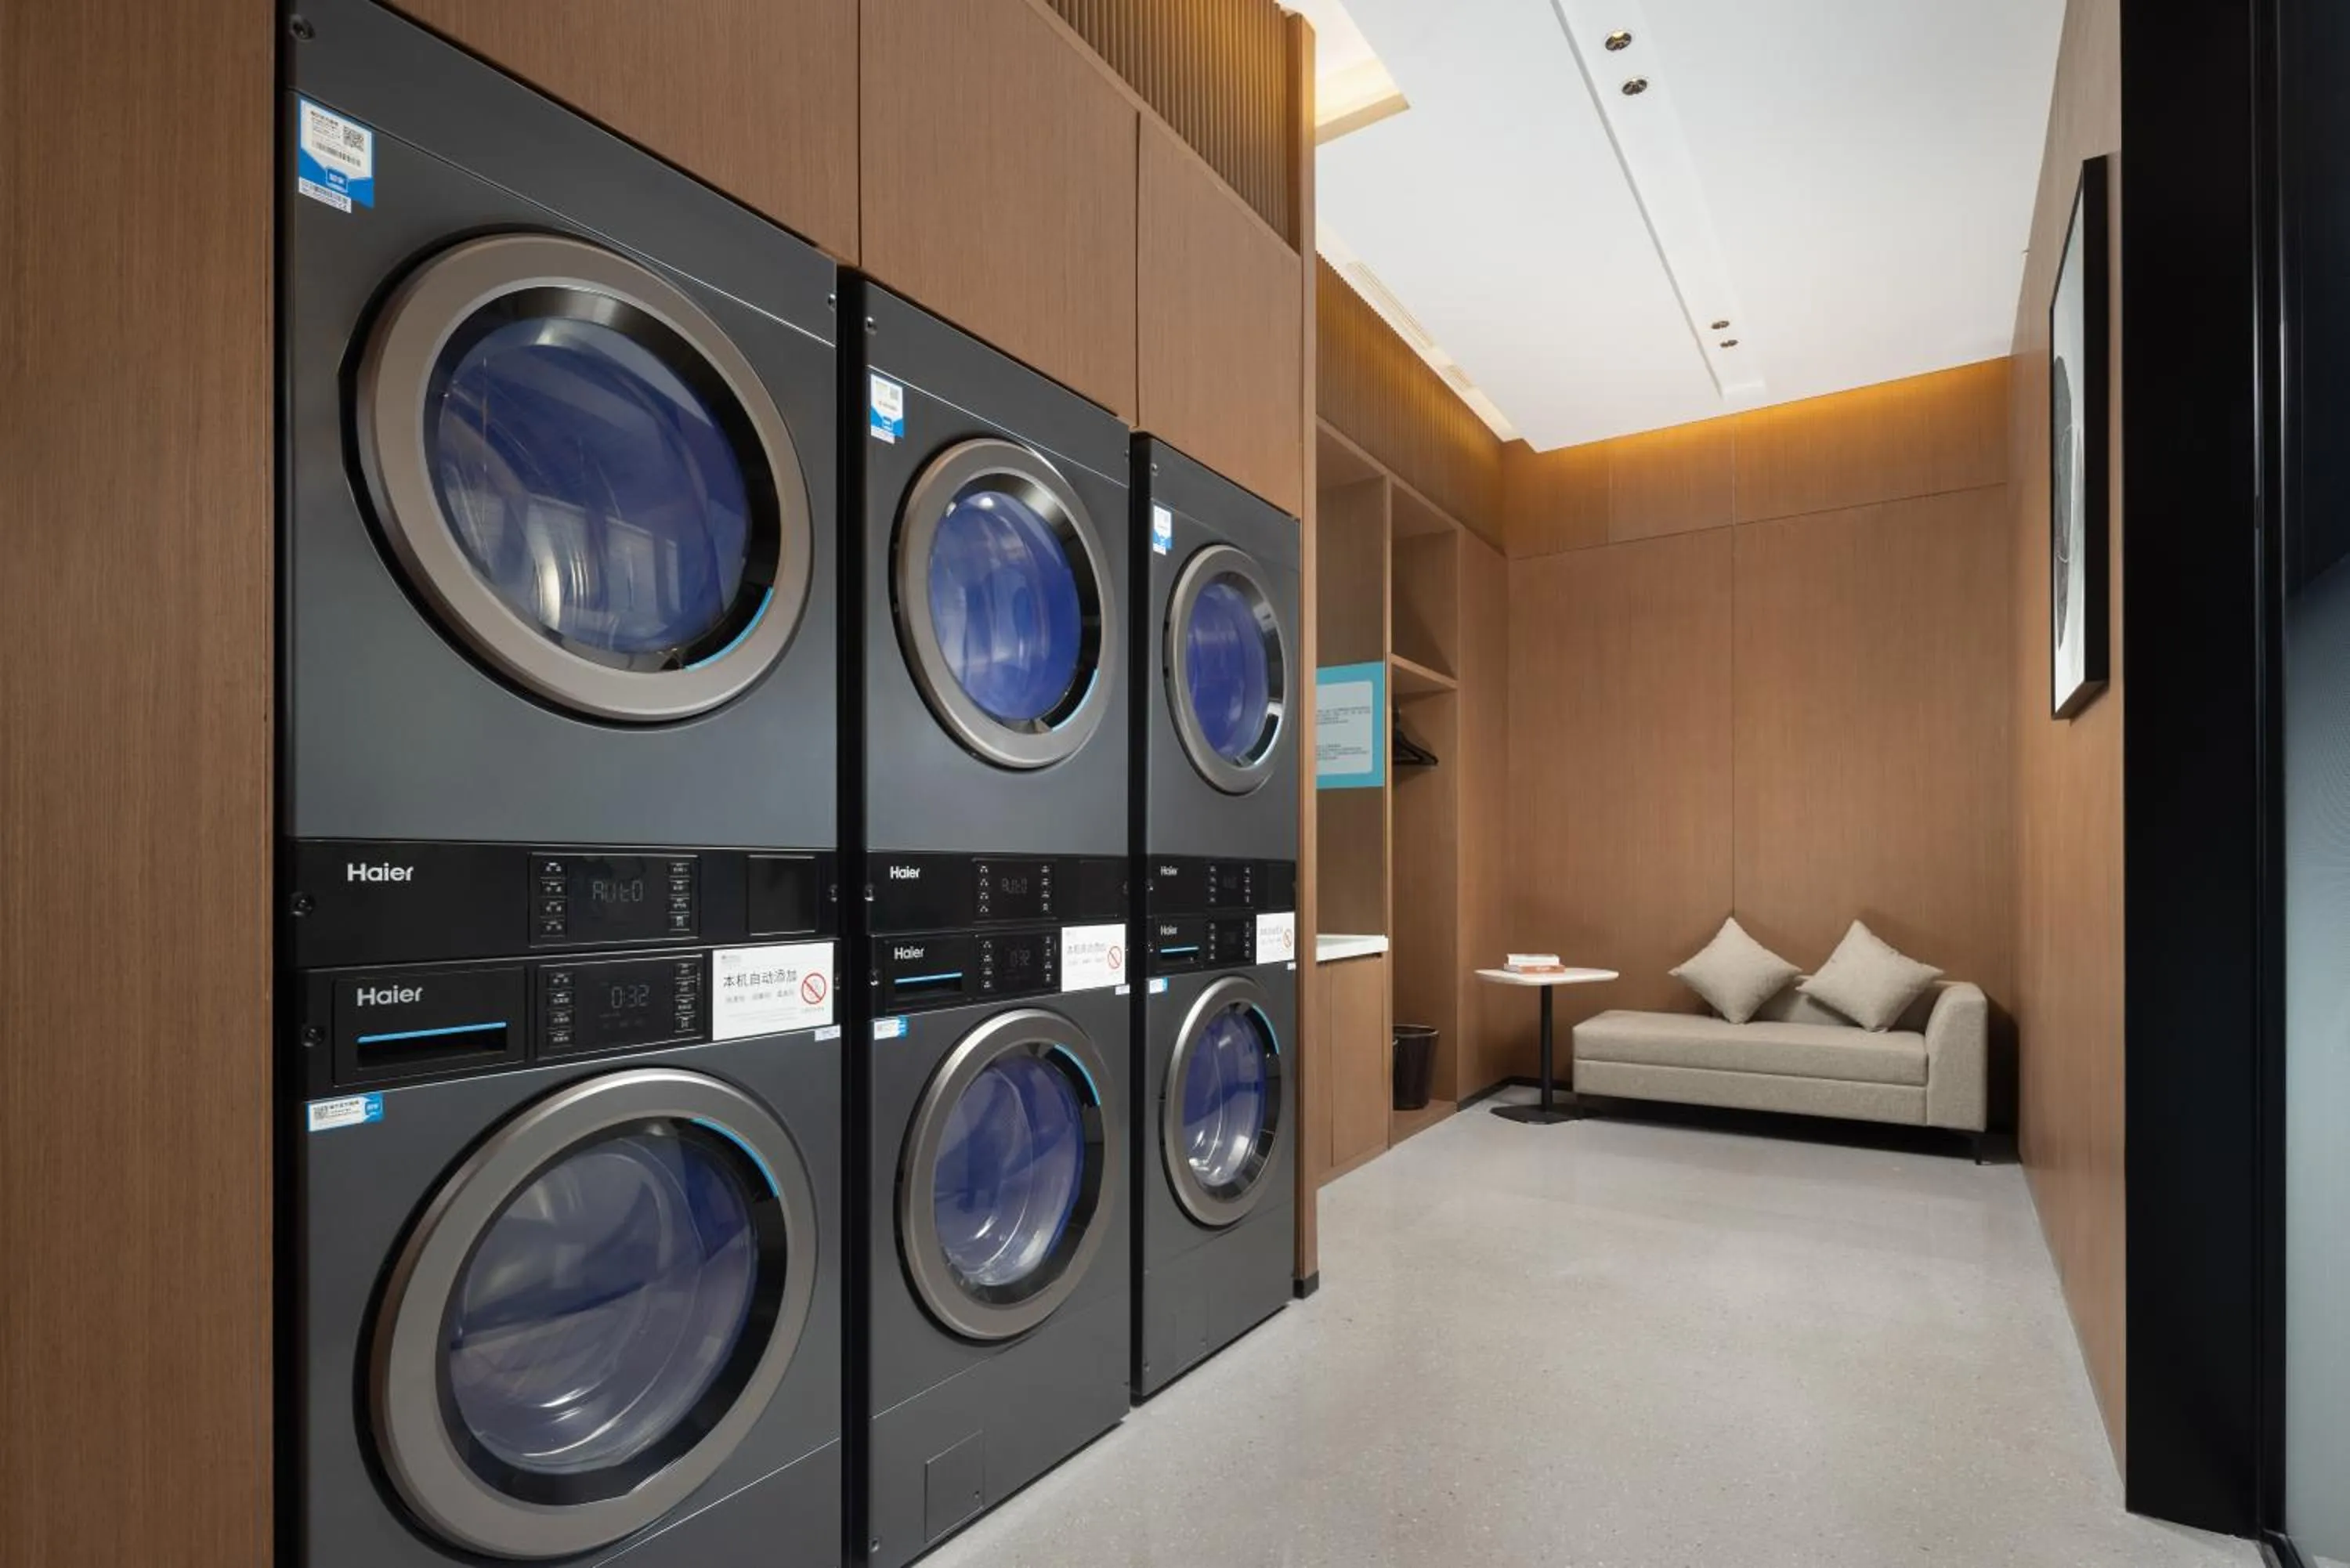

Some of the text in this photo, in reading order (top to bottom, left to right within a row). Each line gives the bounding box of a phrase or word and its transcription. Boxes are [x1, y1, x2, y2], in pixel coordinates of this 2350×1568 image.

[347, 862, 414, 882] Haier
[890, 865, 920, 879] Haier
[894, 946, 924, 960] Haier
[723, 968, 797, 988] 本机自动添加
[357, 985, 423, 1006] Haier
